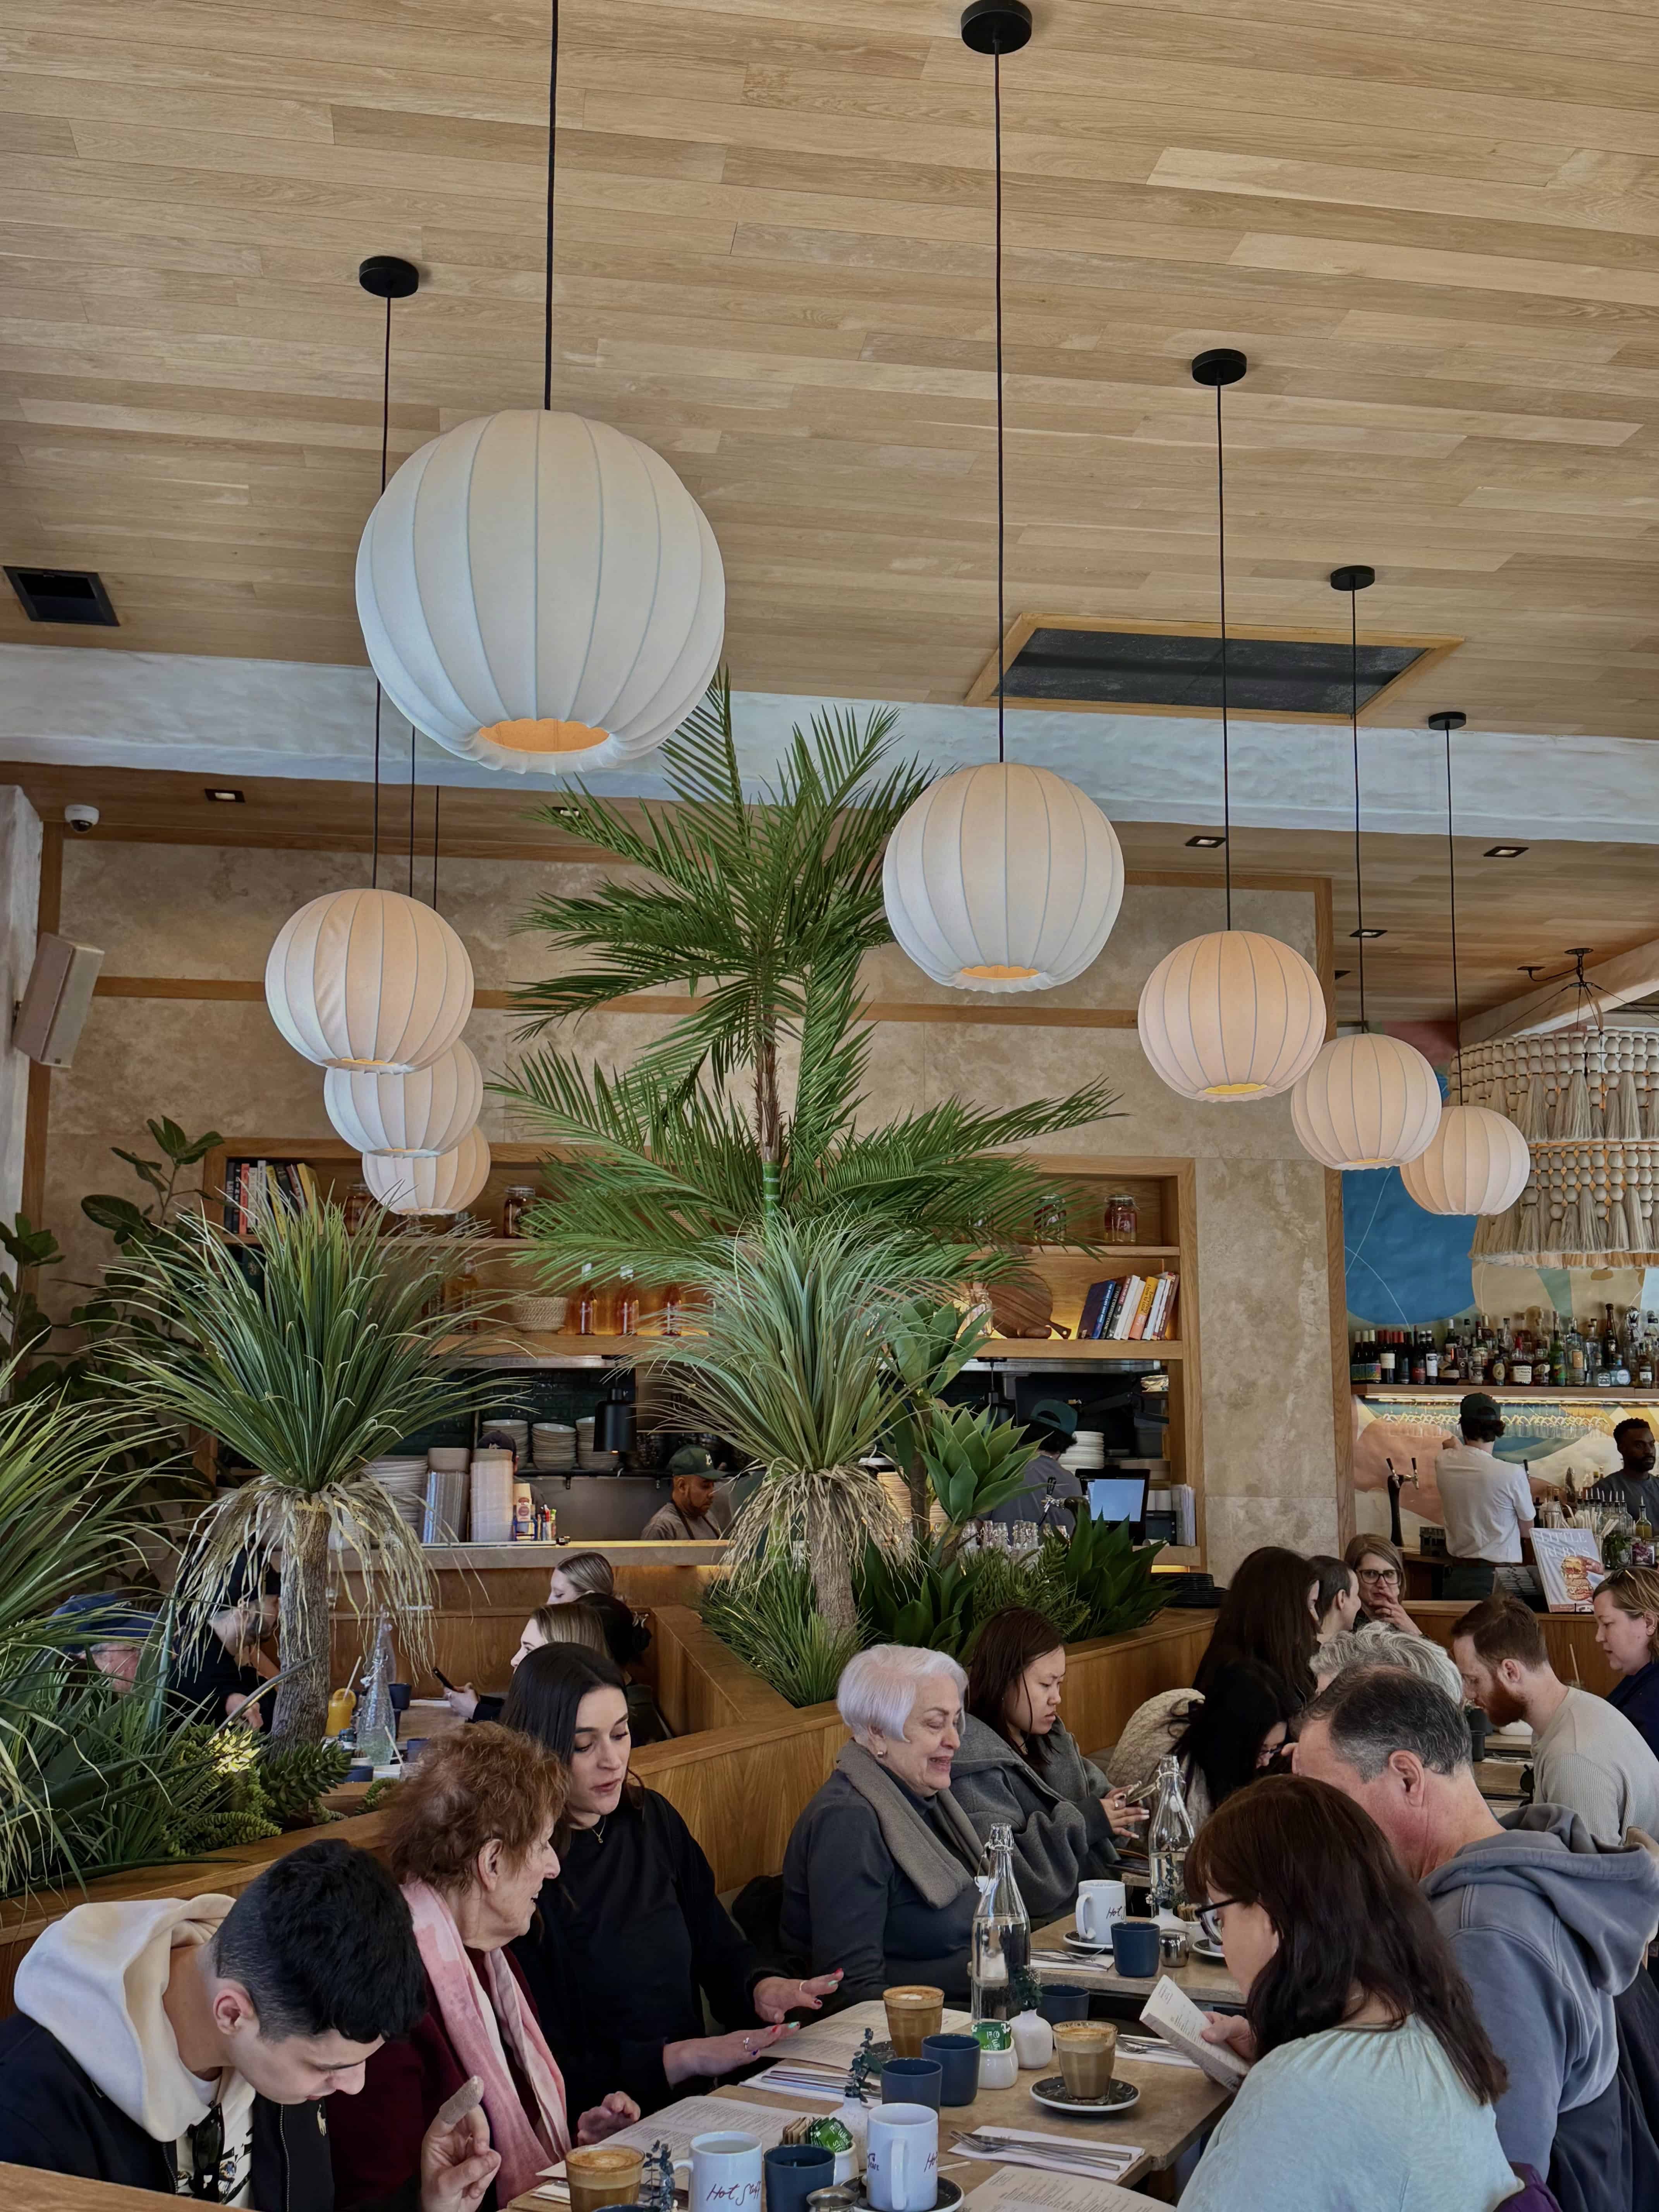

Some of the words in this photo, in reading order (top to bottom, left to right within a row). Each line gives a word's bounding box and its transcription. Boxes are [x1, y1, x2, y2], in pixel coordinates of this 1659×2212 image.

[1540, 1532, 1587, 1542] LITTLE
[1106, 1906, 1122, 1919] Hot
[833, 2140, 843, 2152] STE
[706, 2184, 740, 2201] Hot
